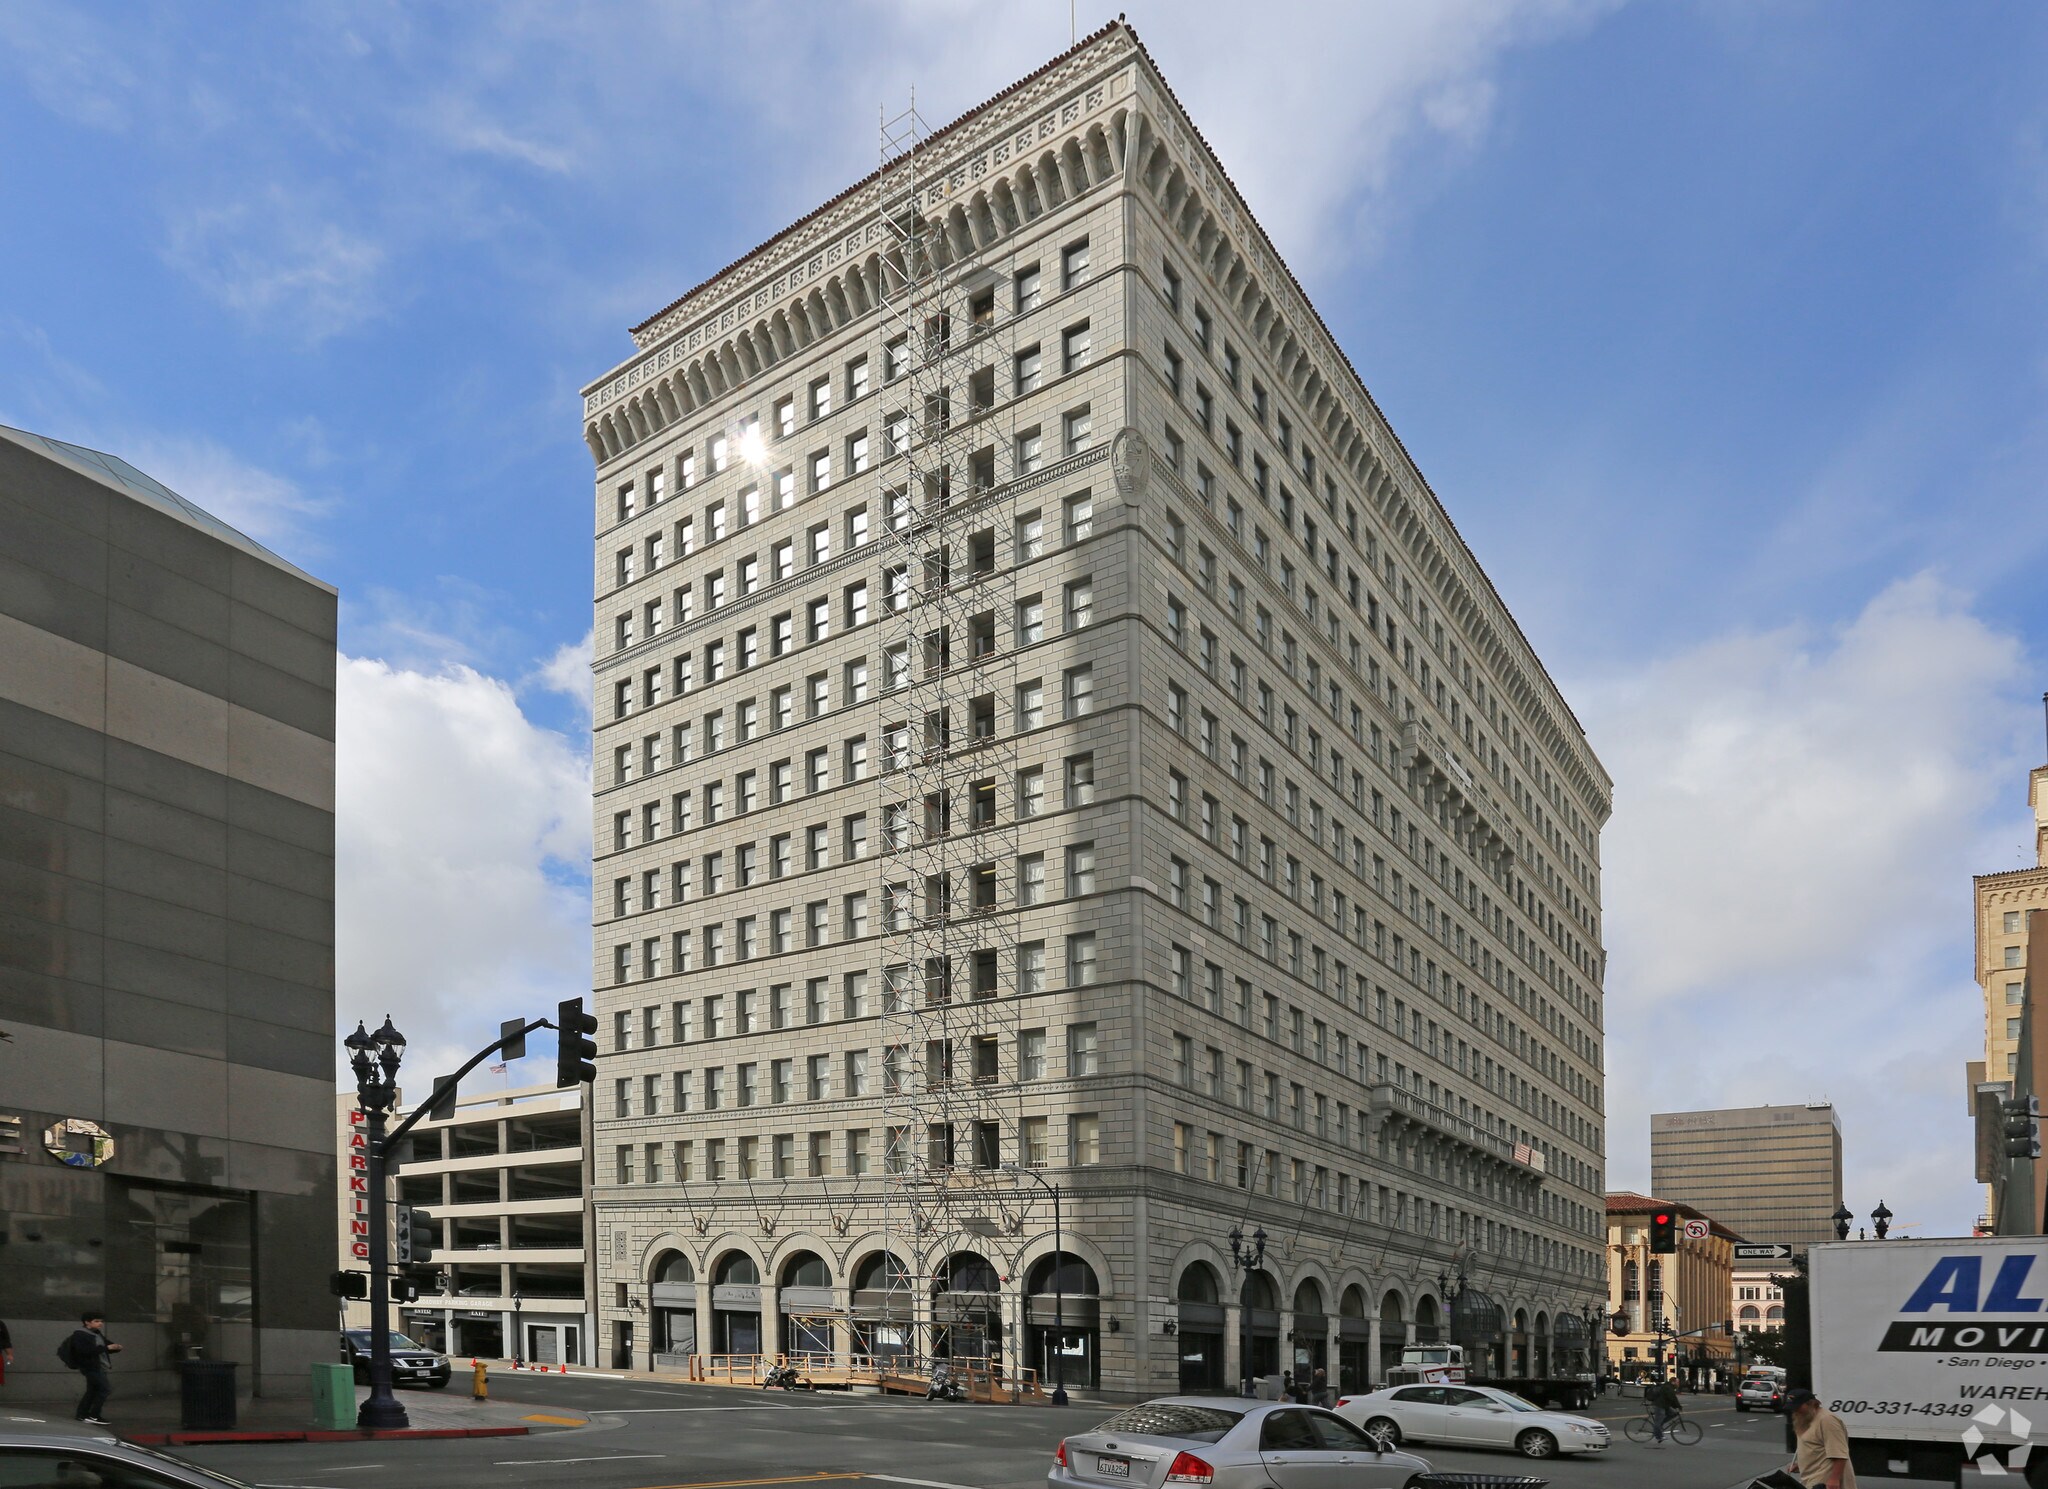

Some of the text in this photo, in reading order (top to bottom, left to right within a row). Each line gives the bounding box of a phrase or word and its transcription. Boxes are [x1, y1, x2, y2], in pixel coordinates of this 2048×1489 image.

[351, 1111, 368, 1257] PARKING
[1899, 1255, 2048, 1313] AL
[1948, 1356, 2036, 1371] San Diego
[1960, 1385, 2048, 1401] WAREH
[1828, 1399, 1974, 1418] 800-331-4349
